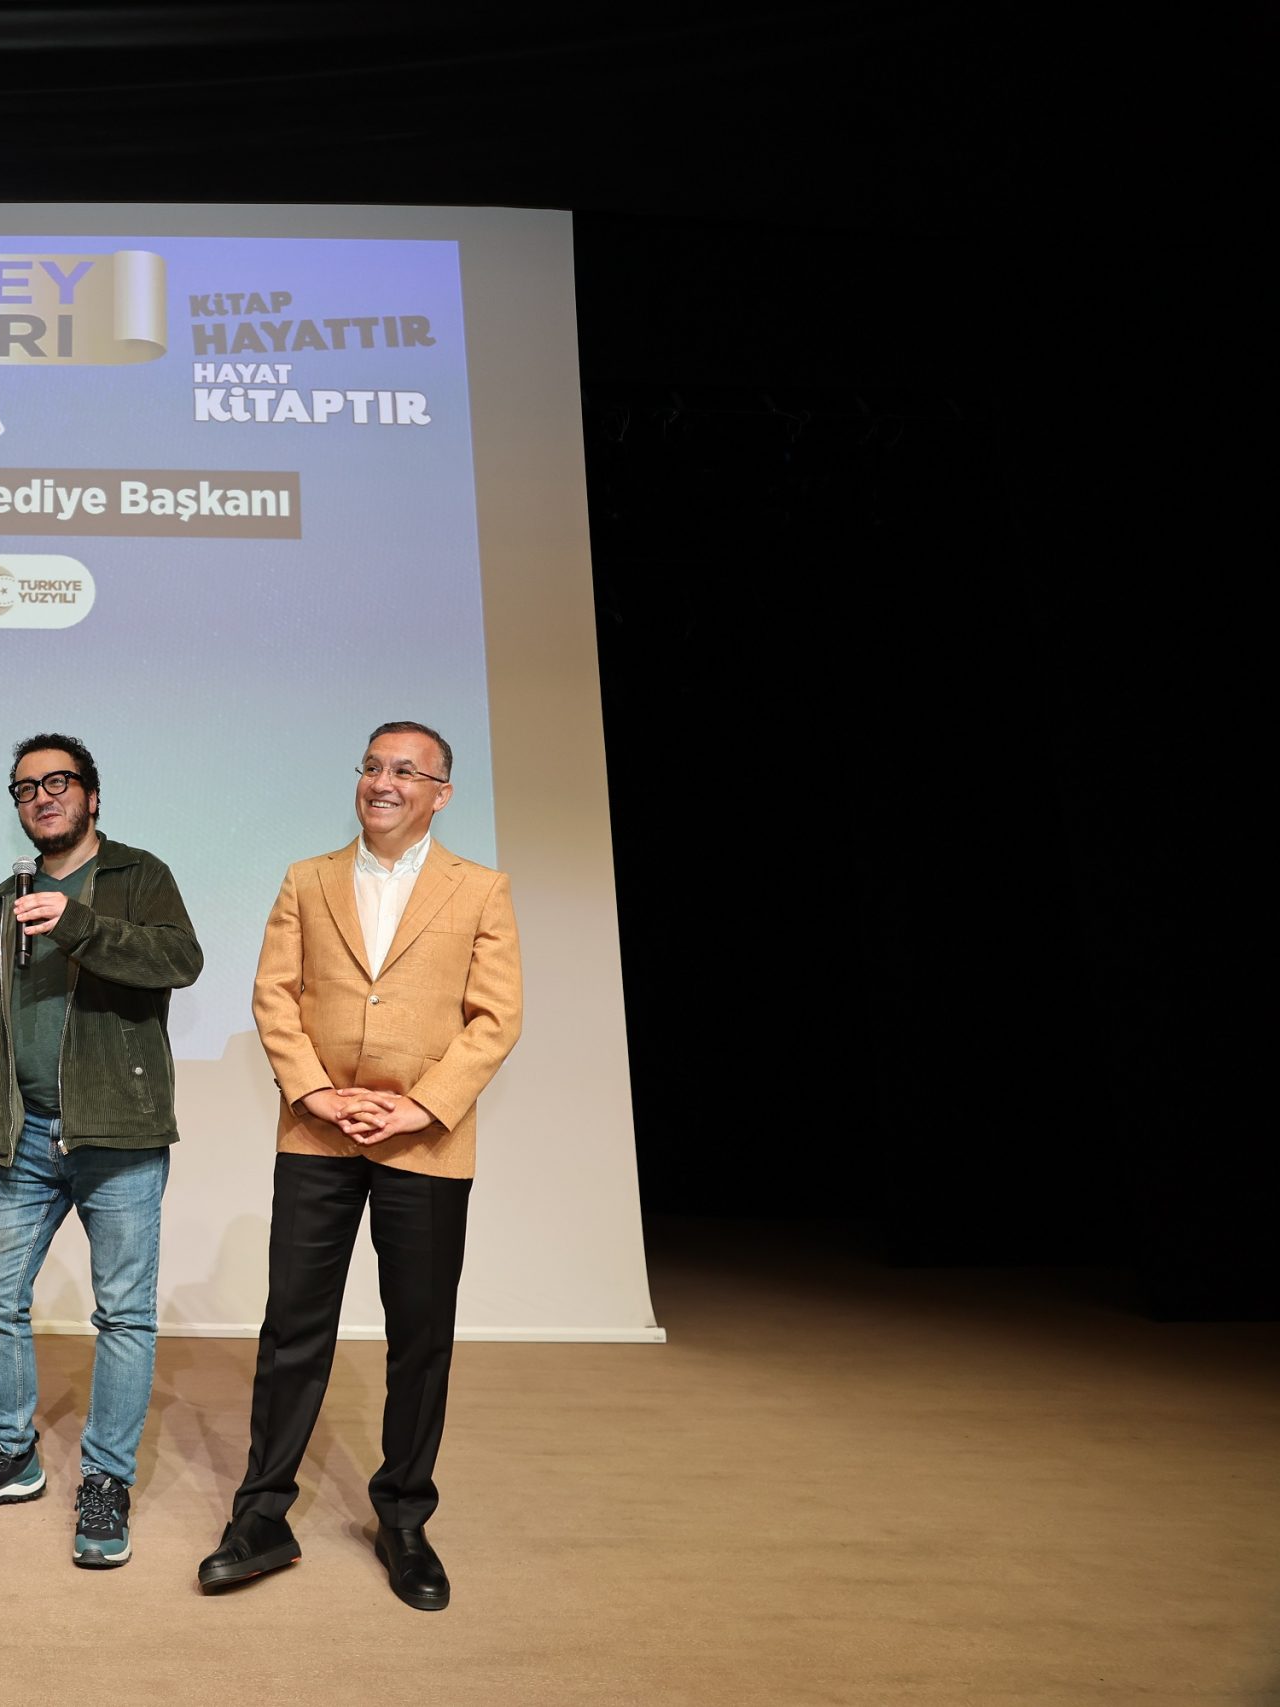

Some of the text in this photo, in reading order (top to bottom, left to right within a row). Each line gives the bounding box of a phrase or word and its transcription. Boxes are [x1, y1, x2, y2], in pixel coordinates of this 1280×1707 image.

[191, 315, 437, 356] HAYATTIR
[192, 361, 293, 385] HAYAT
[120, 480, 290, 522] Başkanı
